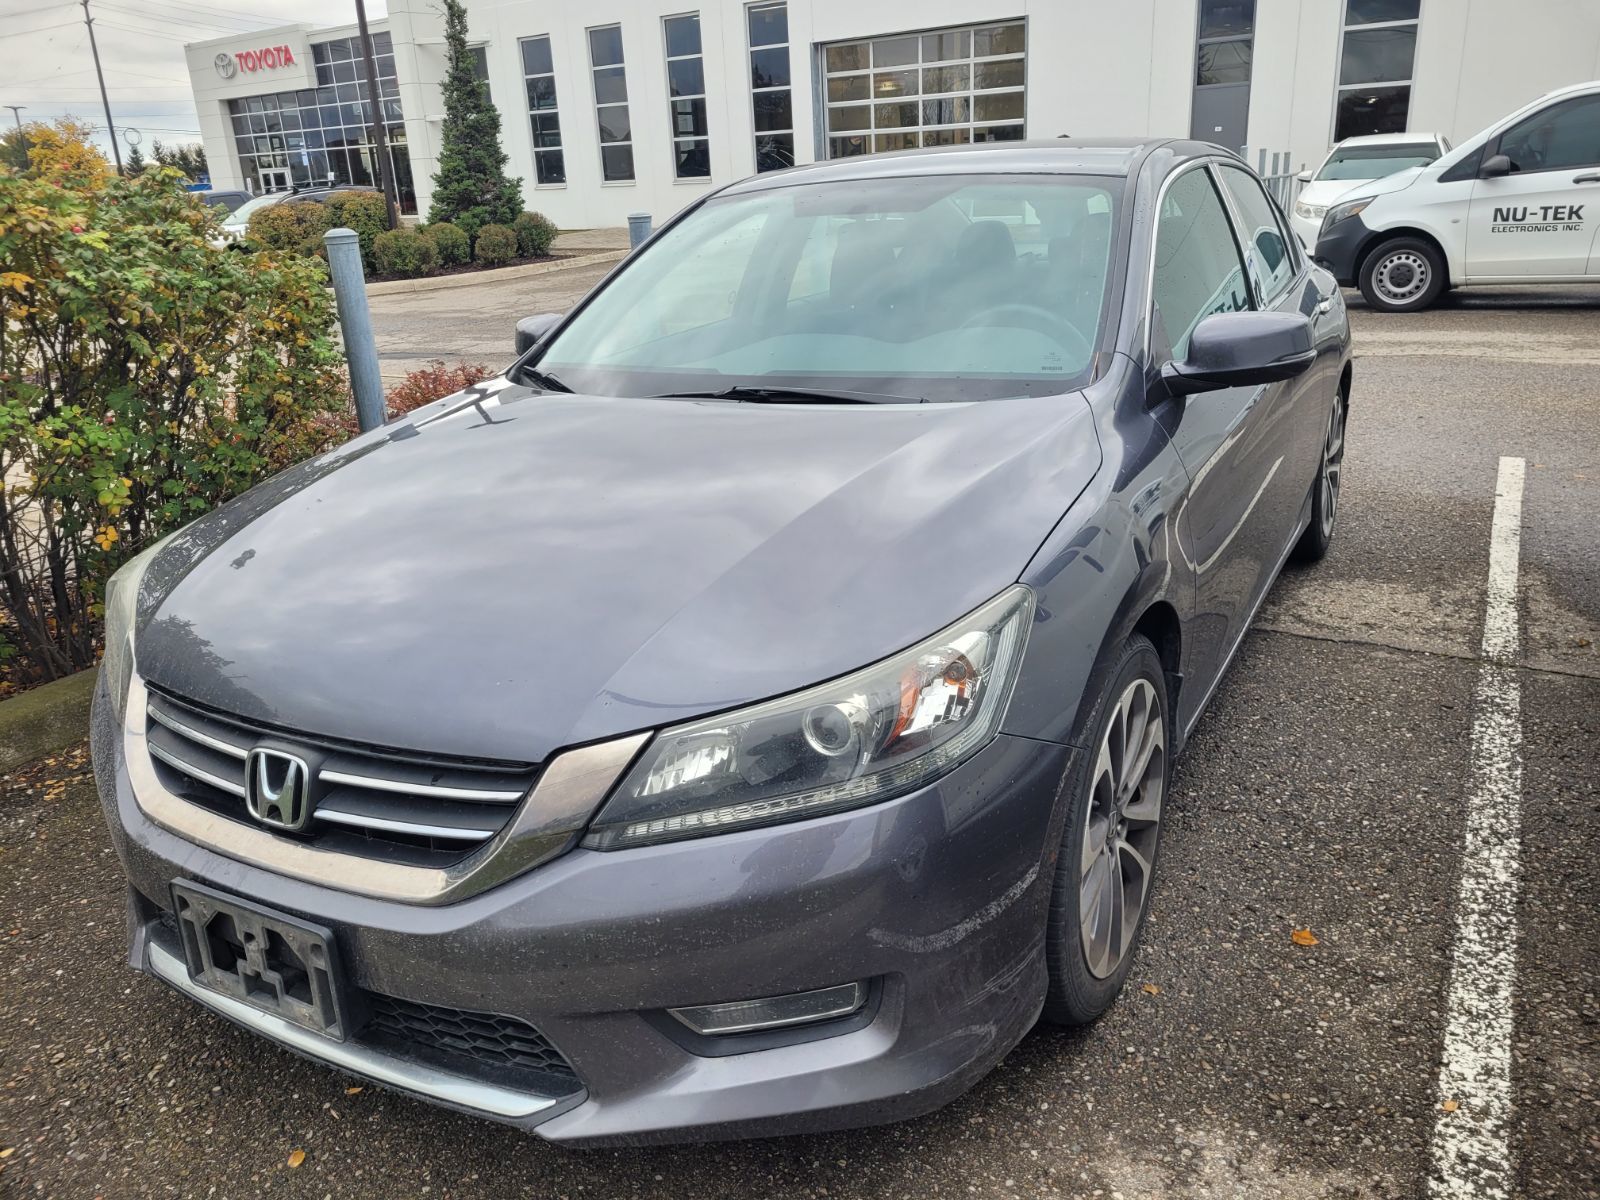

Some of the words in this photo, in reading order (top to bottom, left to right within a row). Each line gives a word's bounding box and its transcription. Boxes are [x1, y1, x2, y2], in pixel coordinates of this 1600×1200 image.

[235, 45, 294, 73] TOYOTA
[1493, 205, 1584, 222] NU-TEK
[1492, 225, 1558, 233] ELECTRONICS
[1562, 224, 1584, 232] INC.
